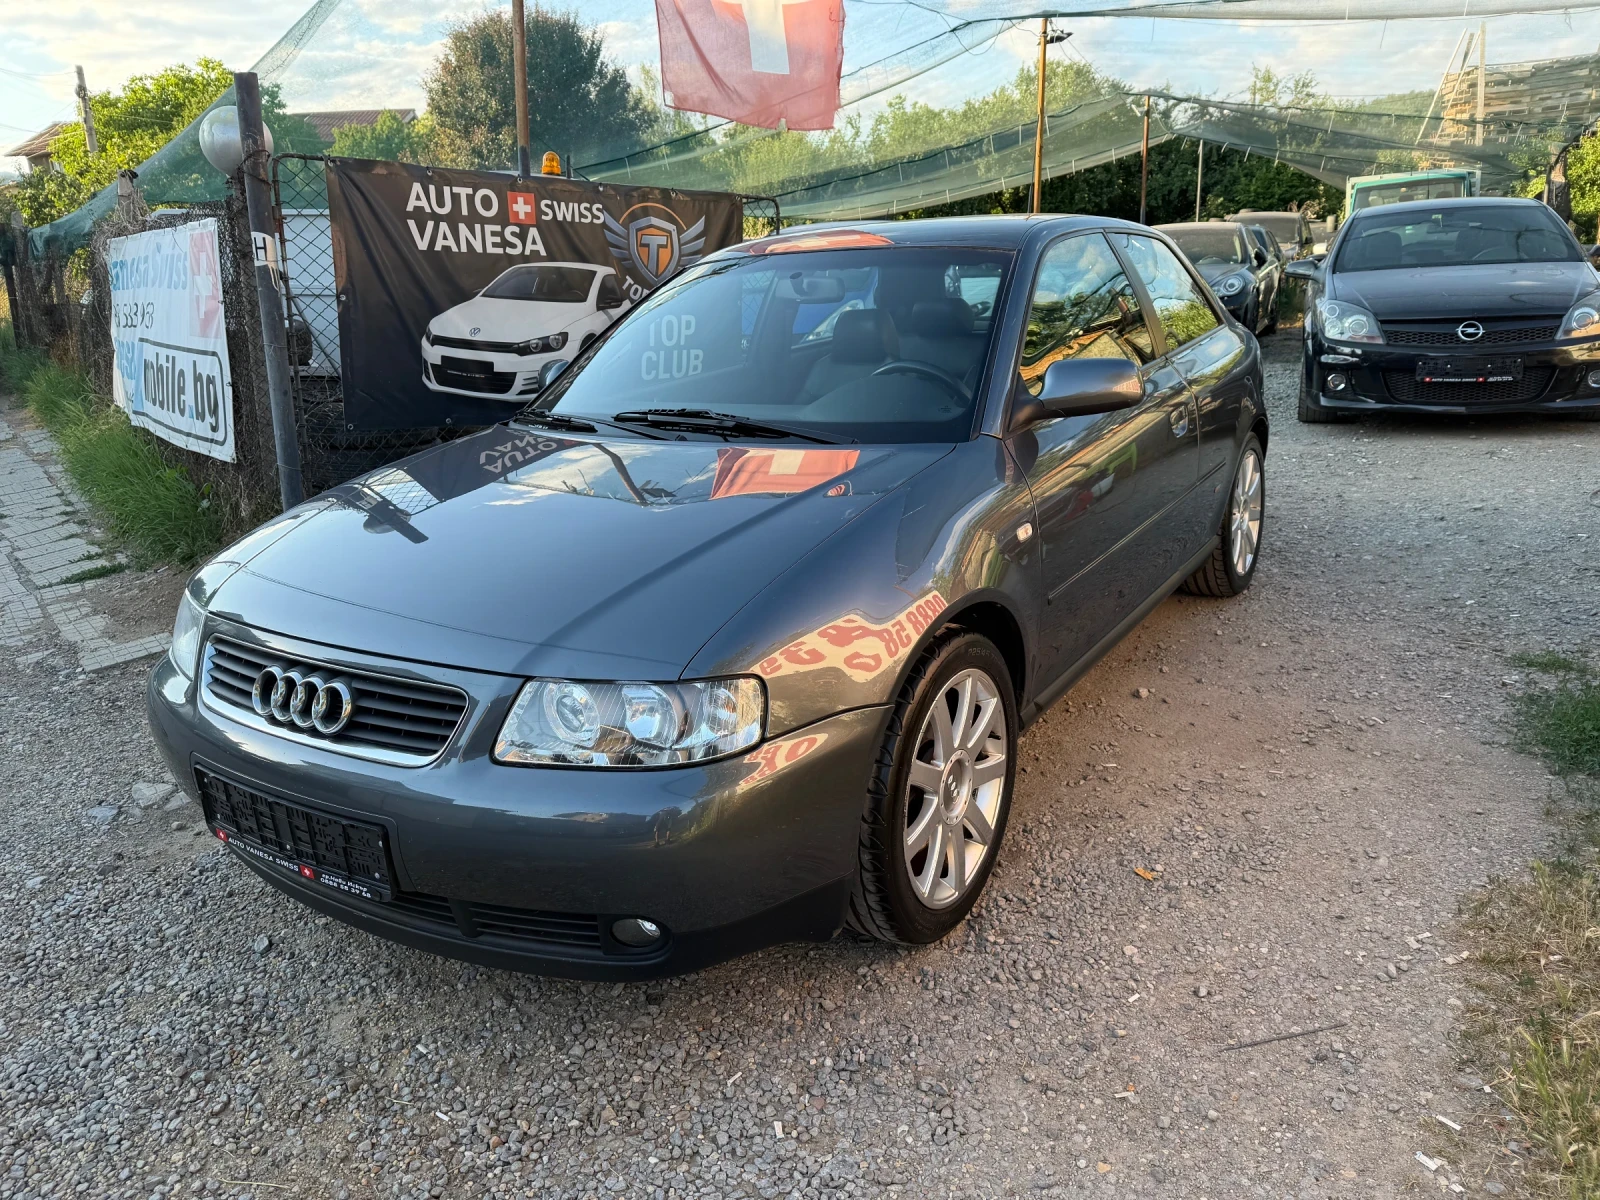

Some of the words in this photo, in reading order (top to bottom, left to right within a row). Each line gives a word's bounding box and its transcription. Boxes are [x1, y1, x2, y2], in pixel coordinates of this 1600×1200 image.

[406, 182, 499, 218] AUTO
[540, 199, 605, 224] SWISS
[406, 219, 547, 256] VANESA
[649, 314, 696, 347] TOP
[641, 348, 704, 380] CLUB
[143, 352, 220, 433] mobile.bg
[228, 837, 245, 849] AUTO
[246, 844, 274, 862] VANESA
[275, 858, 299, 872] SWISS
